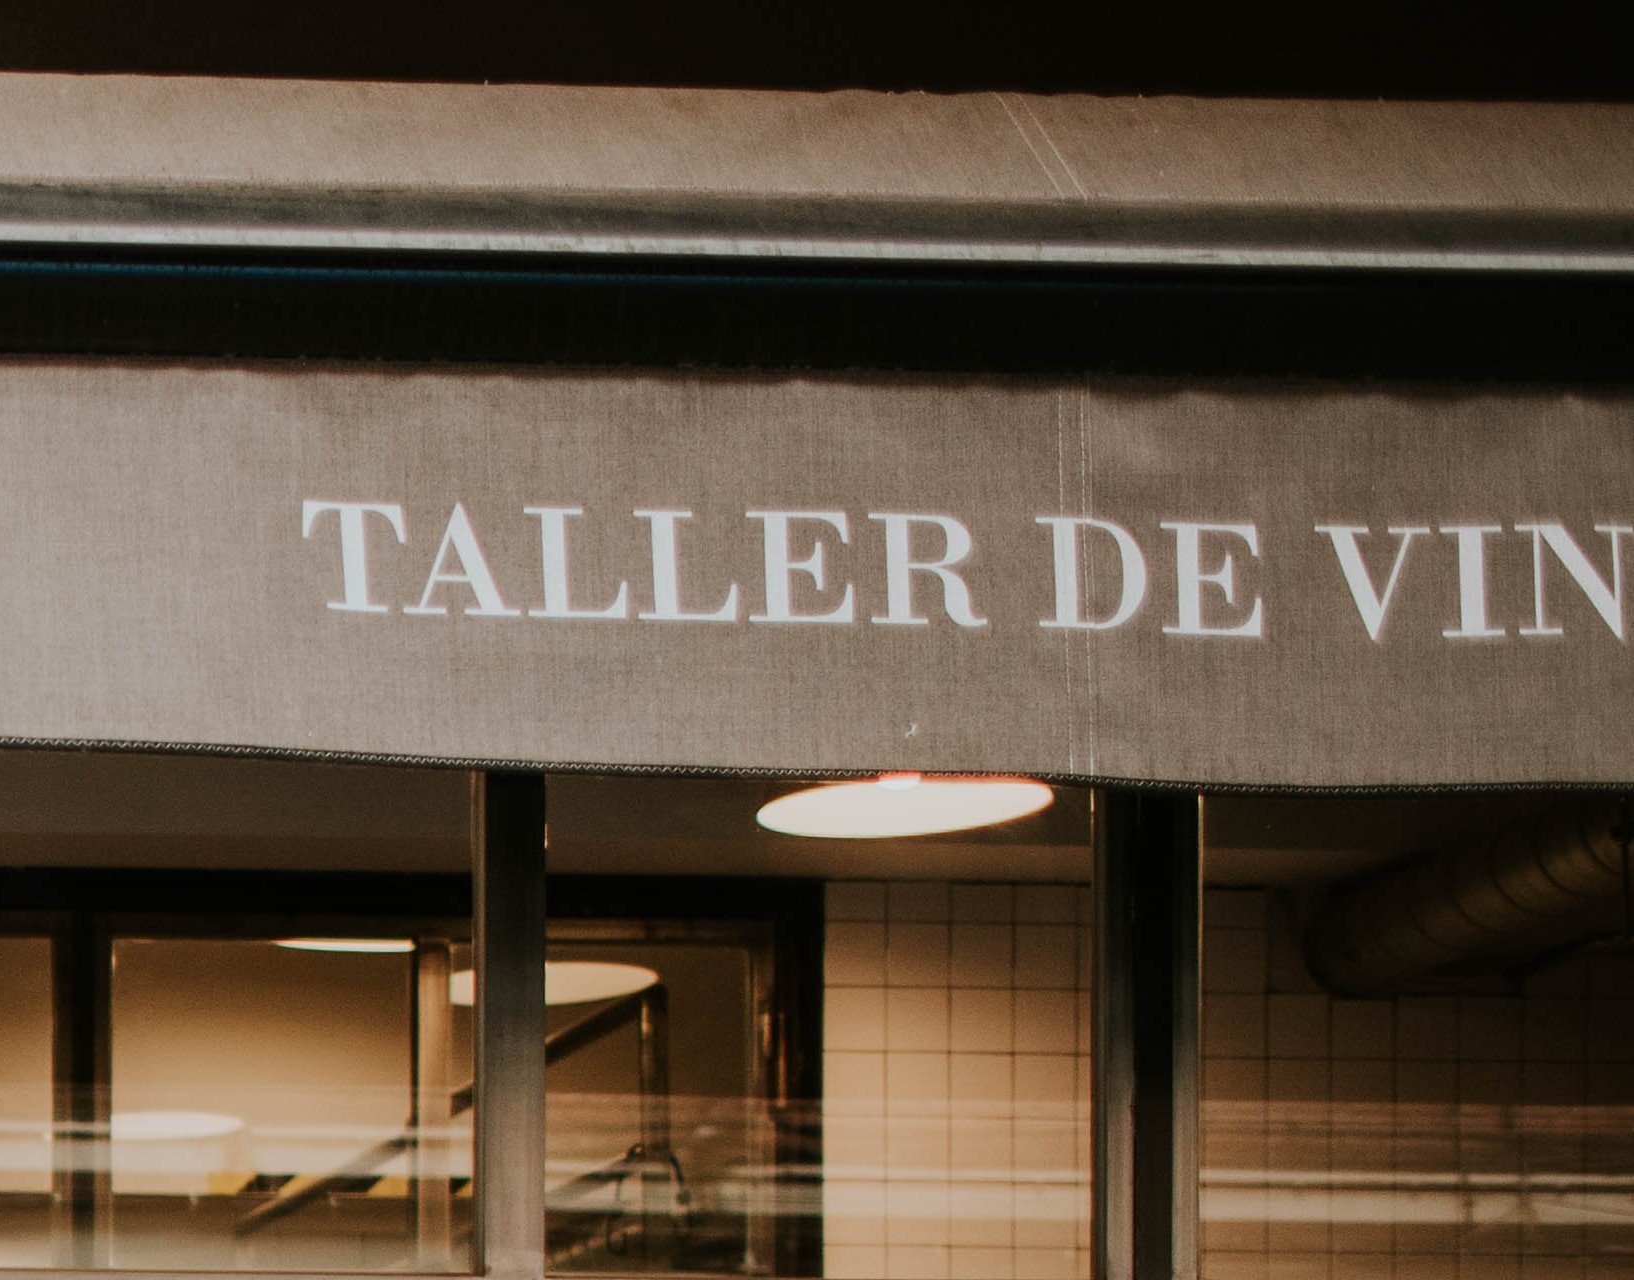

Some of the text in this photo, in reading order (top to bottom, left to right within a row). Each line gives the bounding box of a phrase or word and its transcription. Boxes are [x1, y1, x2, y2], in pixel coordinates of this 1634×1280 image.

[303, 500, 1634, 642] TALLER DE VIN
